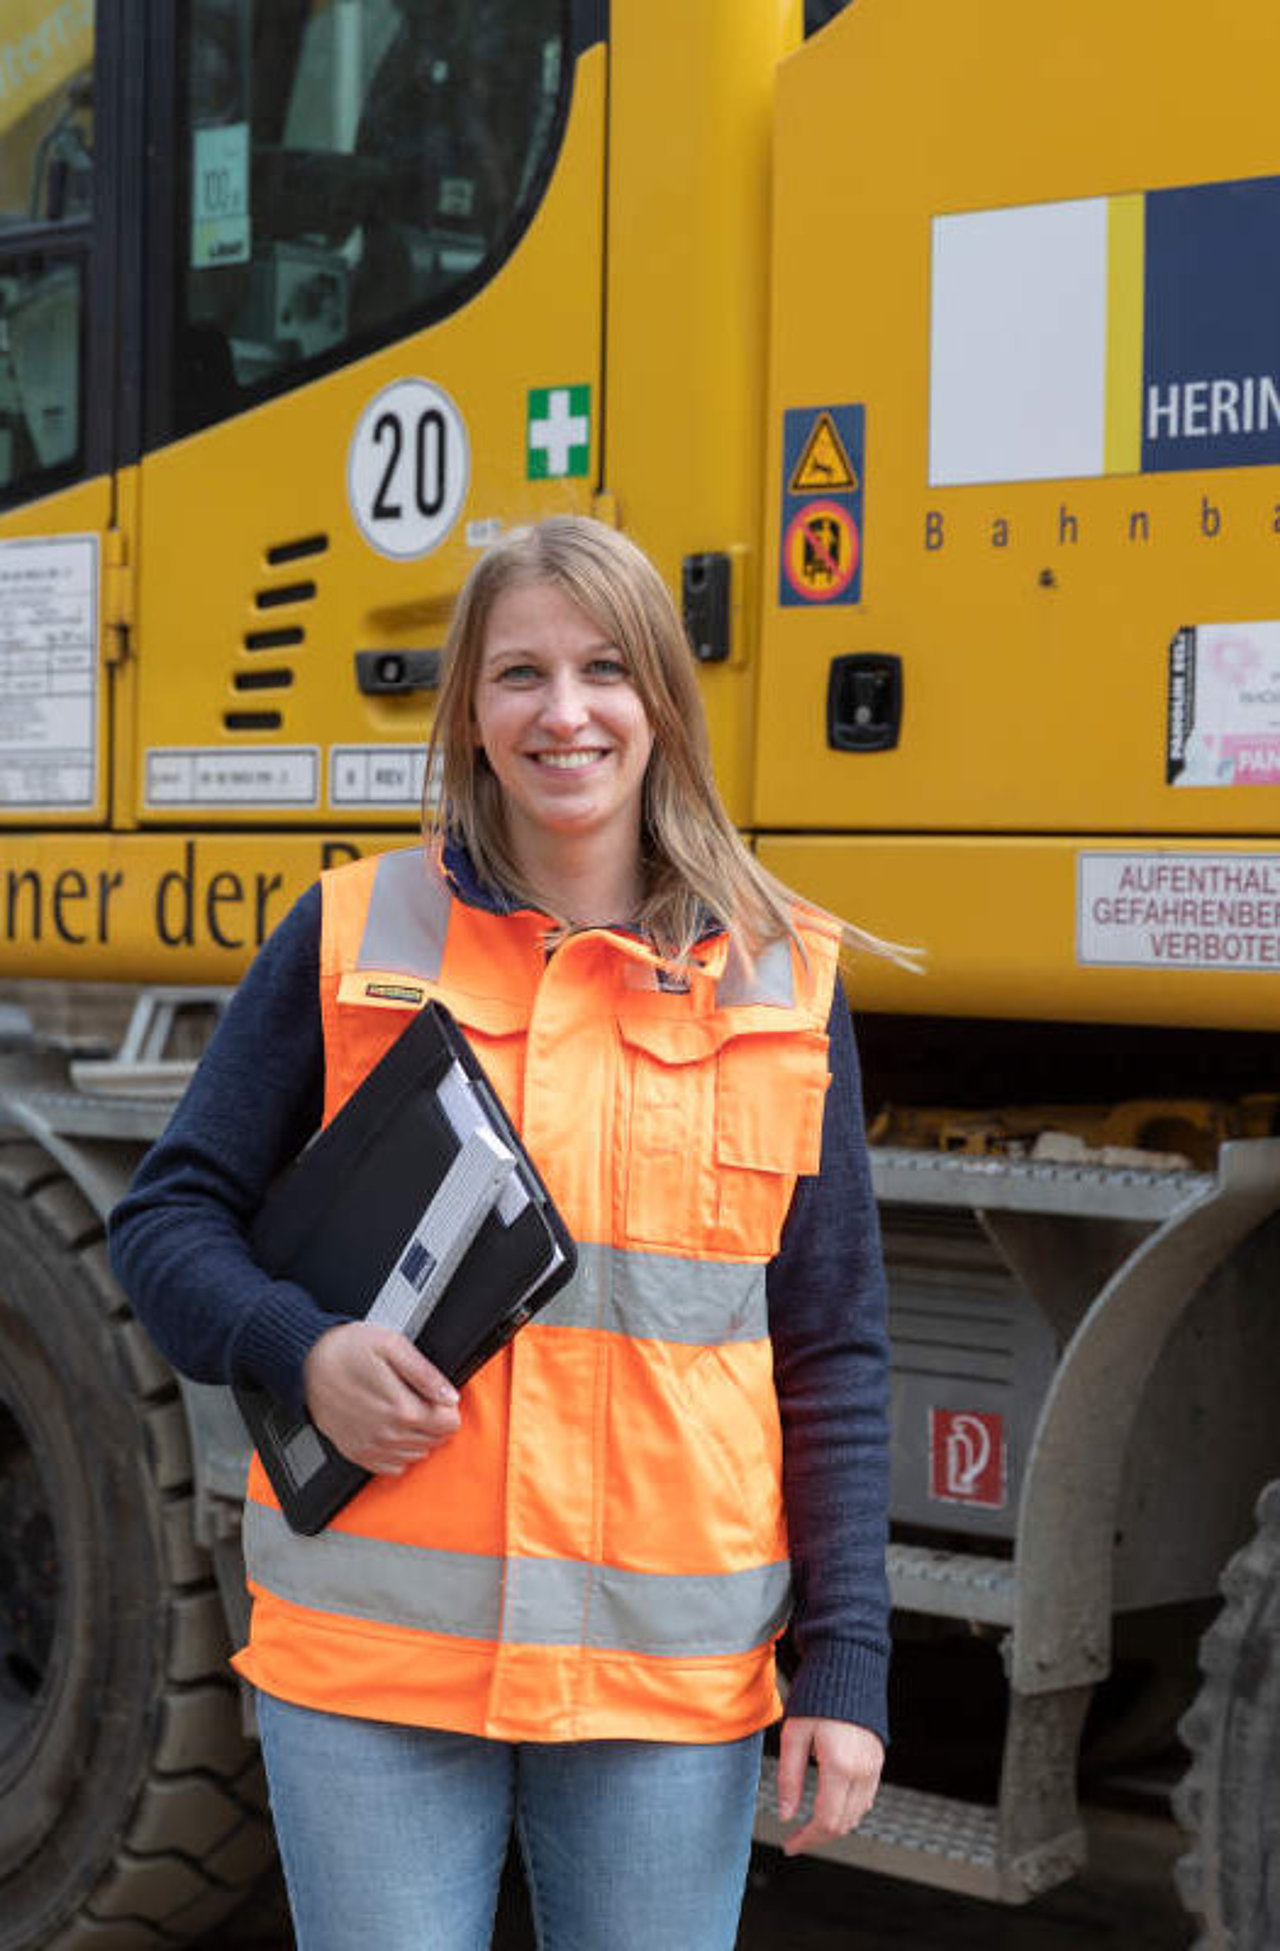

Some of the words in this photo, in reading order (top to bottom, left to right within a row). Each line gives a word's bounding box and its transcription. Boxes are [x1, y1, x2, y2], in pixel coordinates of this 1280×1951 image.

[367, 409, 445, 520] 20
[7, 868, 123, 944] ner
[156, 840, 282, 949] der
[1151, 933, 1280, 962] VERBOTE
